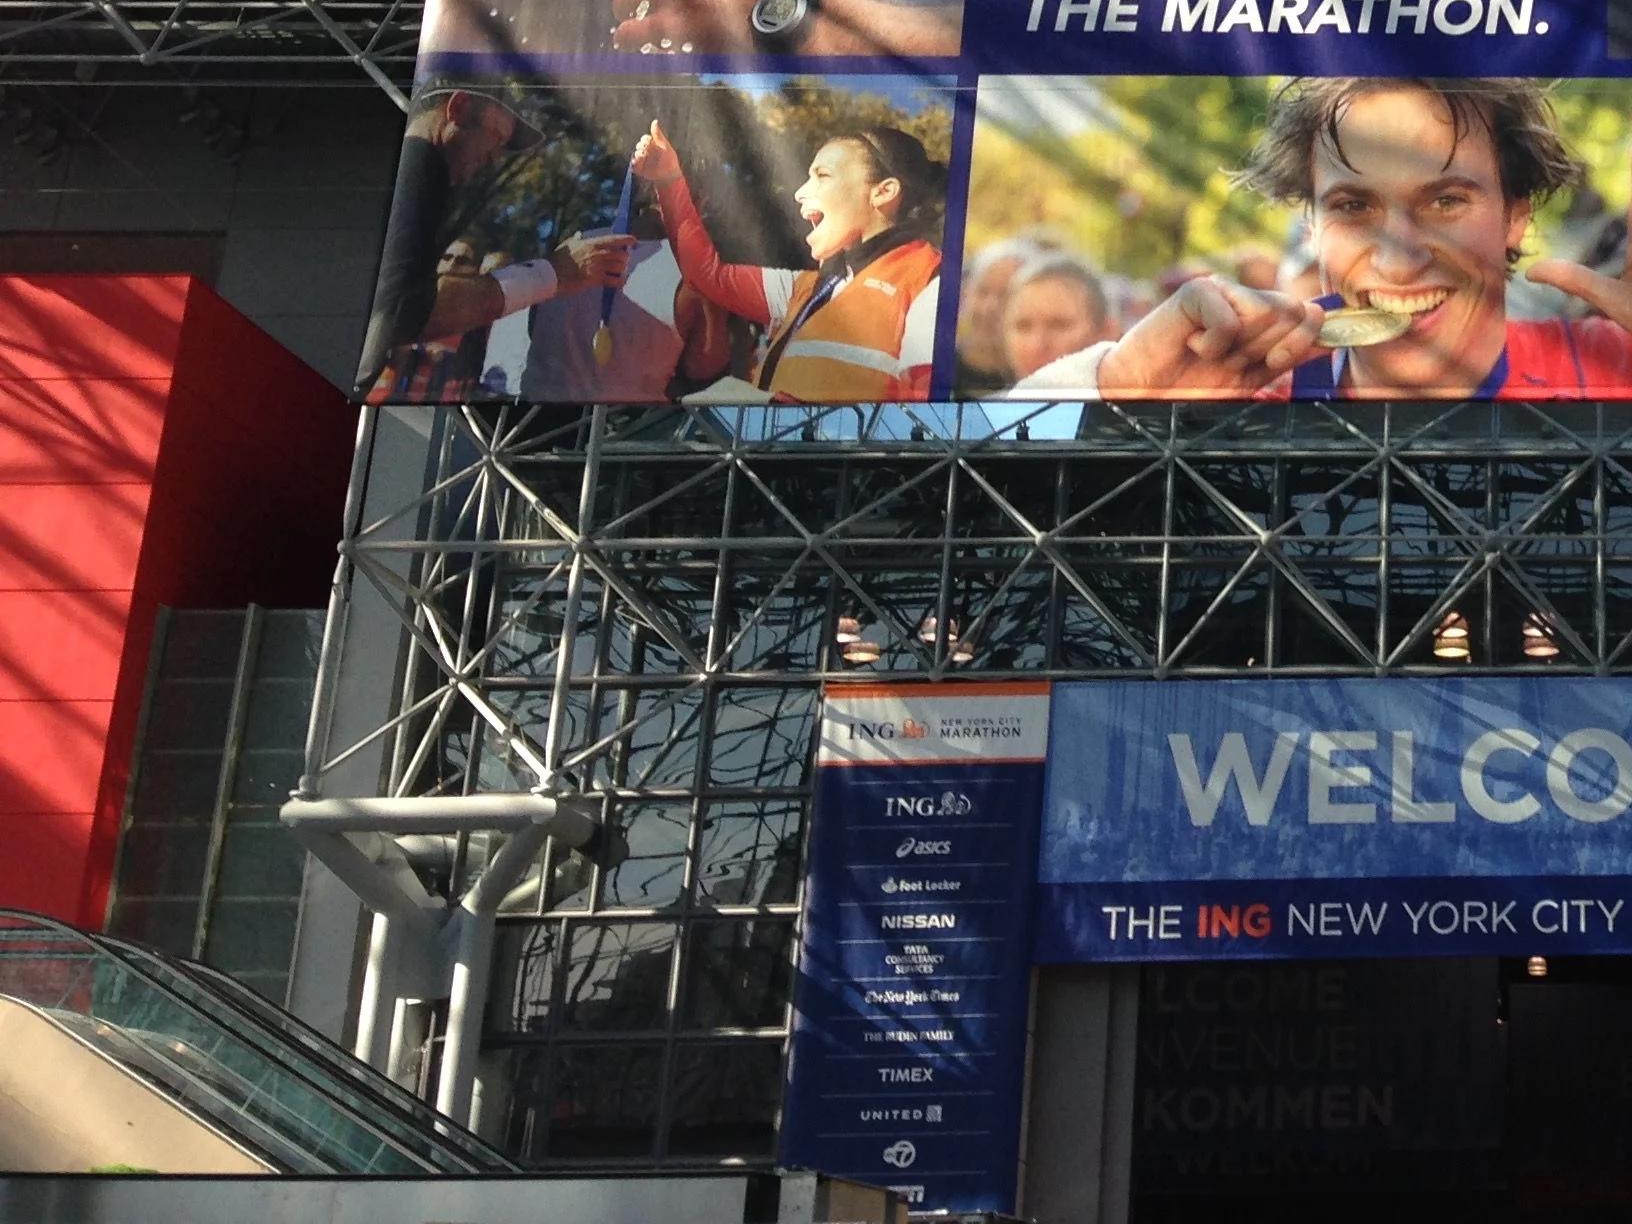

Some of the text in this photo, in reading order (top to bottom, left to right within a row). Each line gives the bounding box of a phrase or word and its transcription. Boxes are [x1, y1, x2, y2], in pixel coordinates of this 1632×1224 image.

[941, 716, 1022, 726] NEW YORK CITY
[849, 722, 895, 740] ING
[939, 727, 1022, 738] MARATHON
[885, 797, 934, 816] ING
[881, 914, 955, 929] NISSAN
[1102, 906, 1182, 942] THE
[1197, 904, 1271, 938] ING
[1287, 902, 1388, 938] NEW
[1400, 900, 1518, 936] YORK
[1531, 898, 1625, 934] CITY
[1155, 968, 1346, 1013] LCOME
[1142, 1025, 1358, 1072] NVENUE
[878, 1068, 933, 1083] TIMEX
[860, 1109, 923, 1121] UNITED
[1142, 1085, 1394, 1132] KOMMEN
